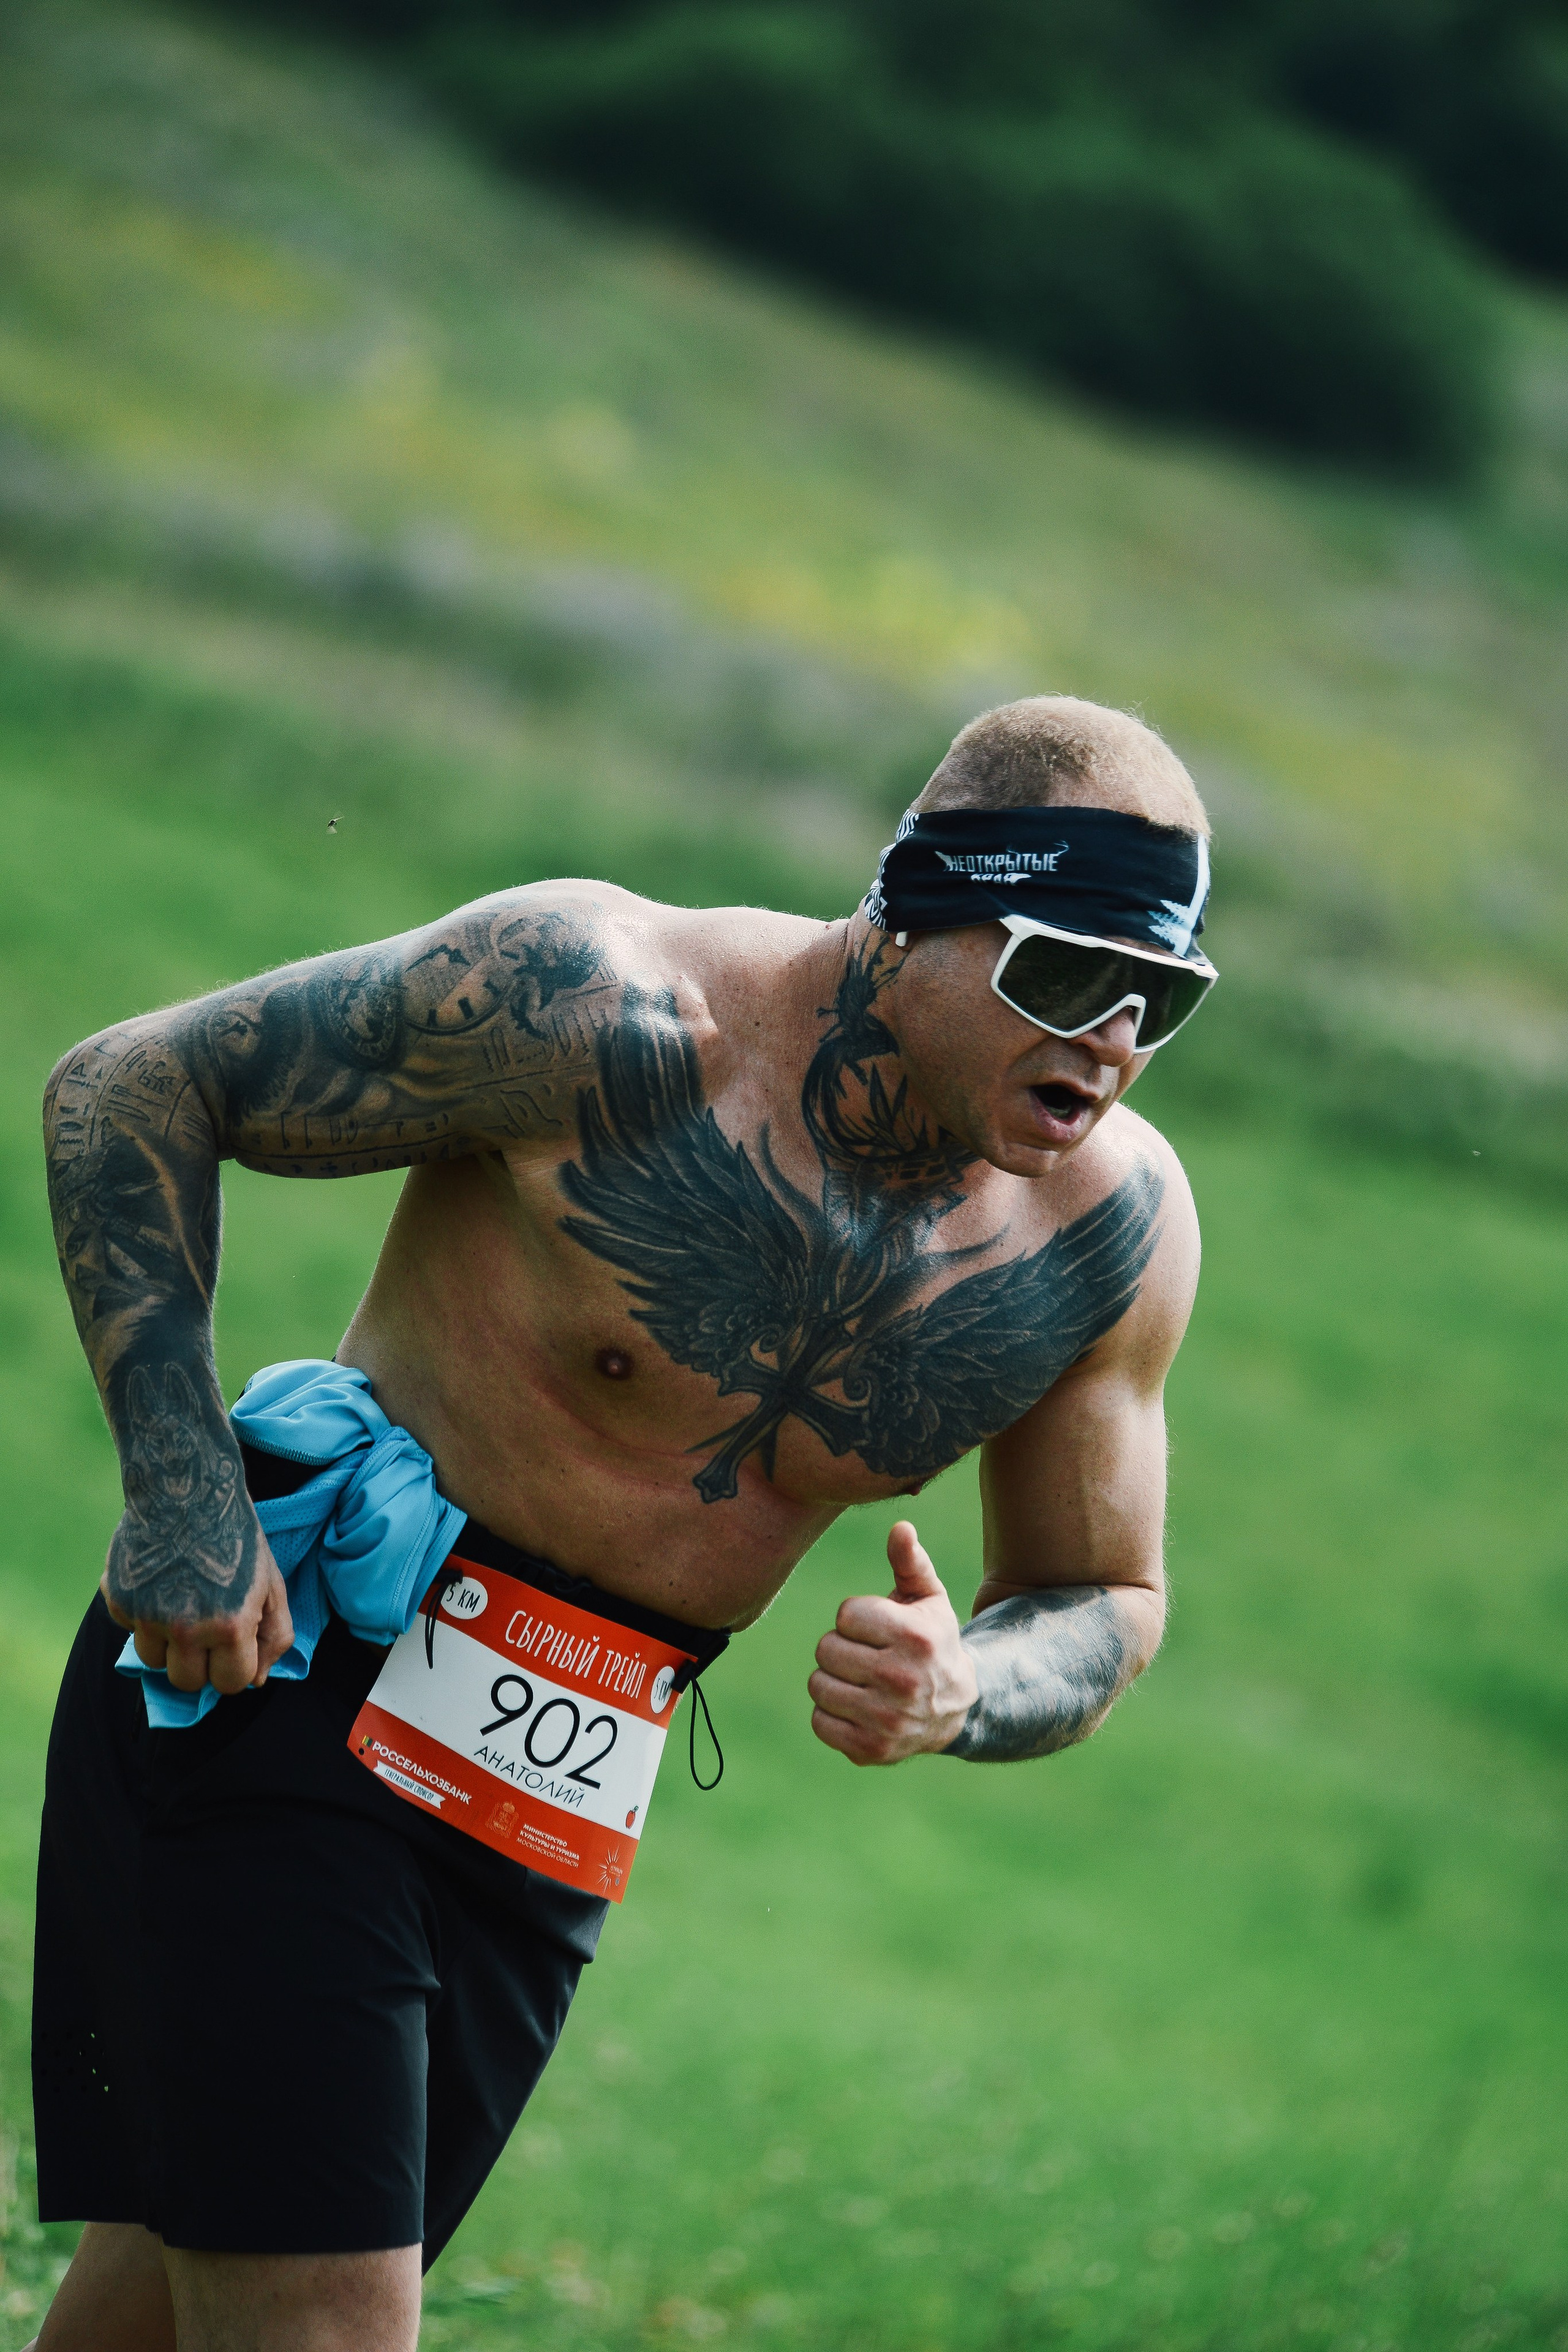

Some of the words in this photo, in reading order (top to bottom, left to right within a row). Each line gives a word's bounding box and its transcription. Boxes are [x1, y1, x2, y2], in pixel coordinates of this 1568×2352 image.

[937, 849, 1061, 873] НЕОТКРЫТЫЕ
[445, 1583, 456, 1602] 5
[505, 1610, 600, 1678] СЫРНЫЙ
[598, 1649, 647, 1699] ТРЕЙЛ
[480, 1674, 617, 1790] 902
[372, 1740, 472, 1805] РОССЕЛЬХОЗБАНК
[384, 1768, 414, 1790] ГЕНЕРАЛЬНЫЙ
[413, 1784, 434, 1801] СПОНСОР
[473, 1746, 585, 1808] АНАТОЛИЙ
[519, 1830, 549, 1849] КУЛЬТУРЫ
[556, 1846, 580, 1861] ТУРИЗМА
[522, 1823, 568, 1847] МИНИСТЕРСТВО
[516, 1838, 556, 1860] МОСКОВСКОЙ
[556, 1854, 579, 1868] ОБЛАСТИ
